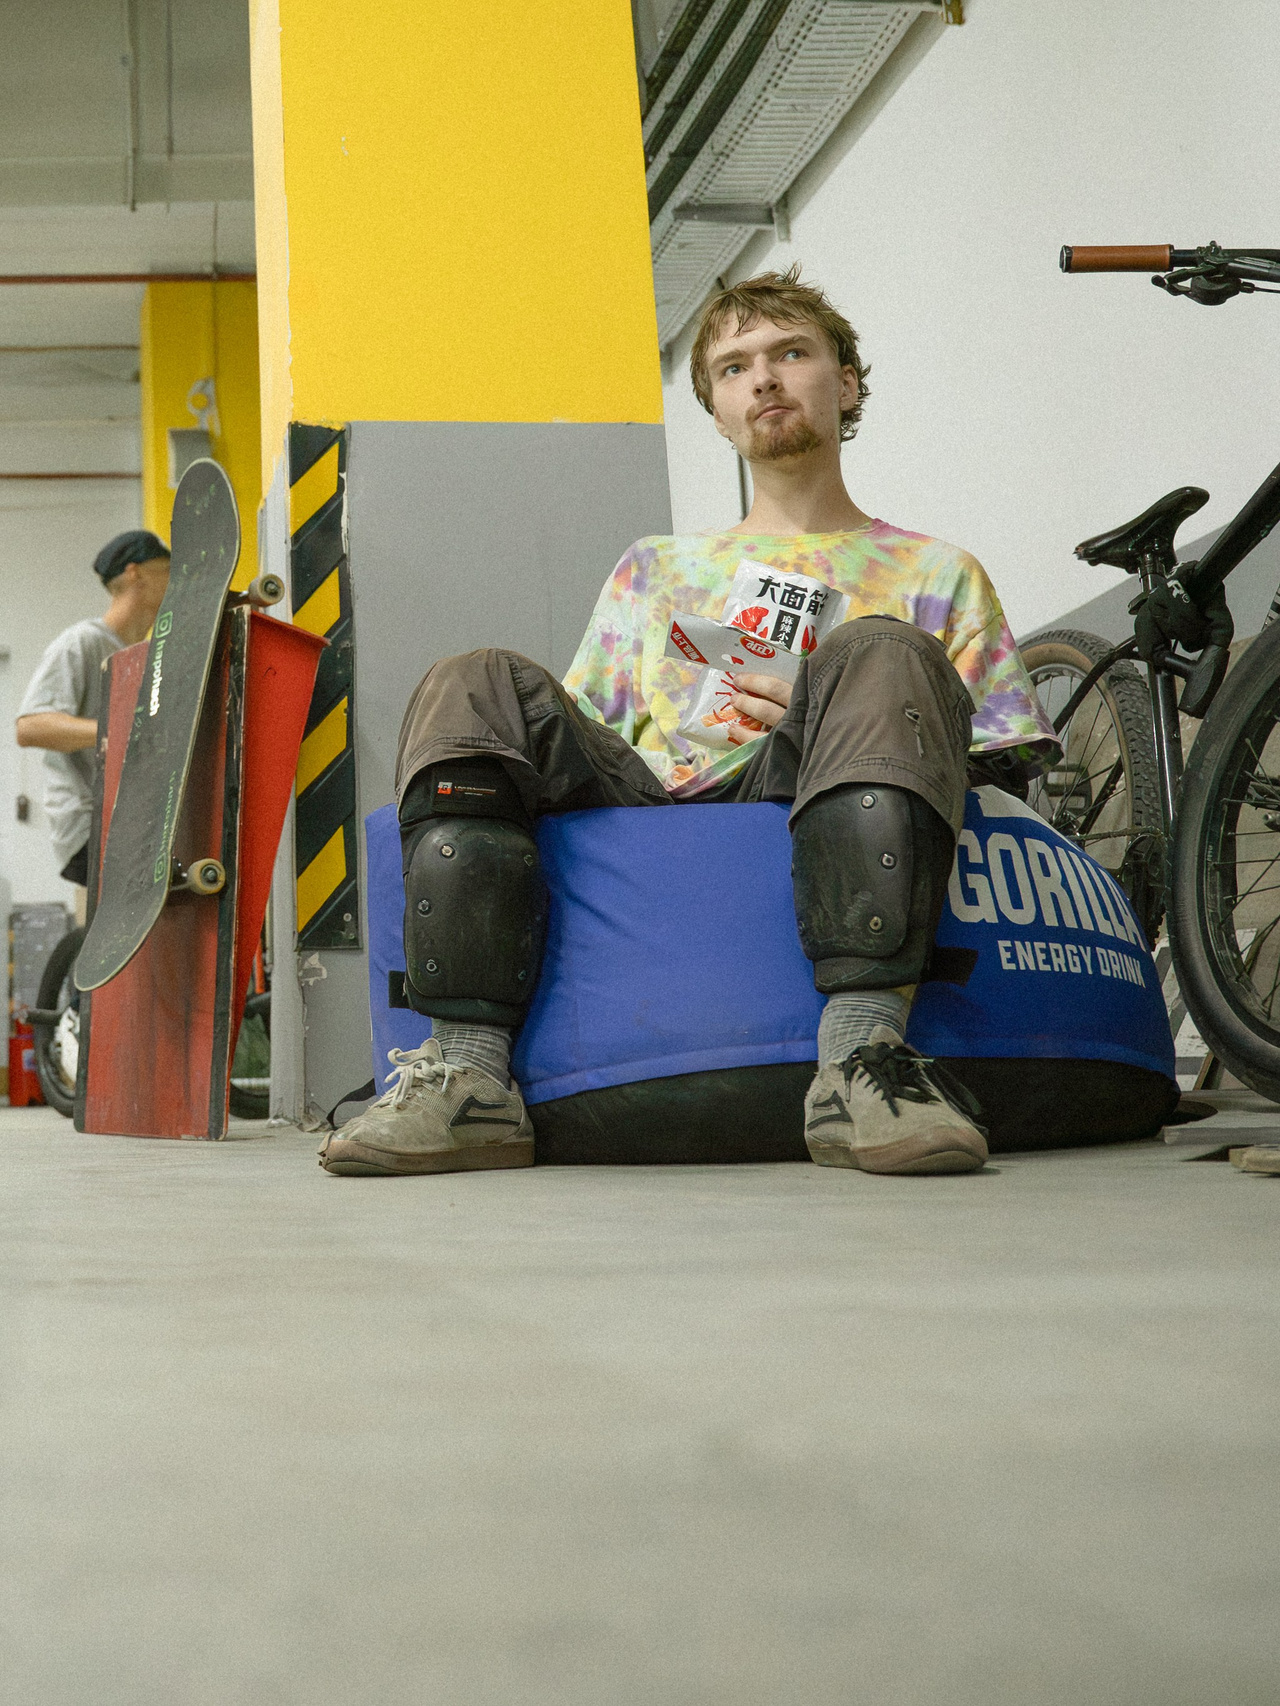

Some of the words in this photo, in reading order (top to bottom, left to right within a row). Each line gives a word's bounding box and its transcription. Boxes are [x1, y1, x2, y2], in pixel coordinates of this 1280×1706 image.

[755, 575, 829, 617] 大面筋
[948, 828, 1148, 953] GORILLA
[997, 939, 1093, 975] ENERGY
[1095, 945, 1147, 989] DRINK
